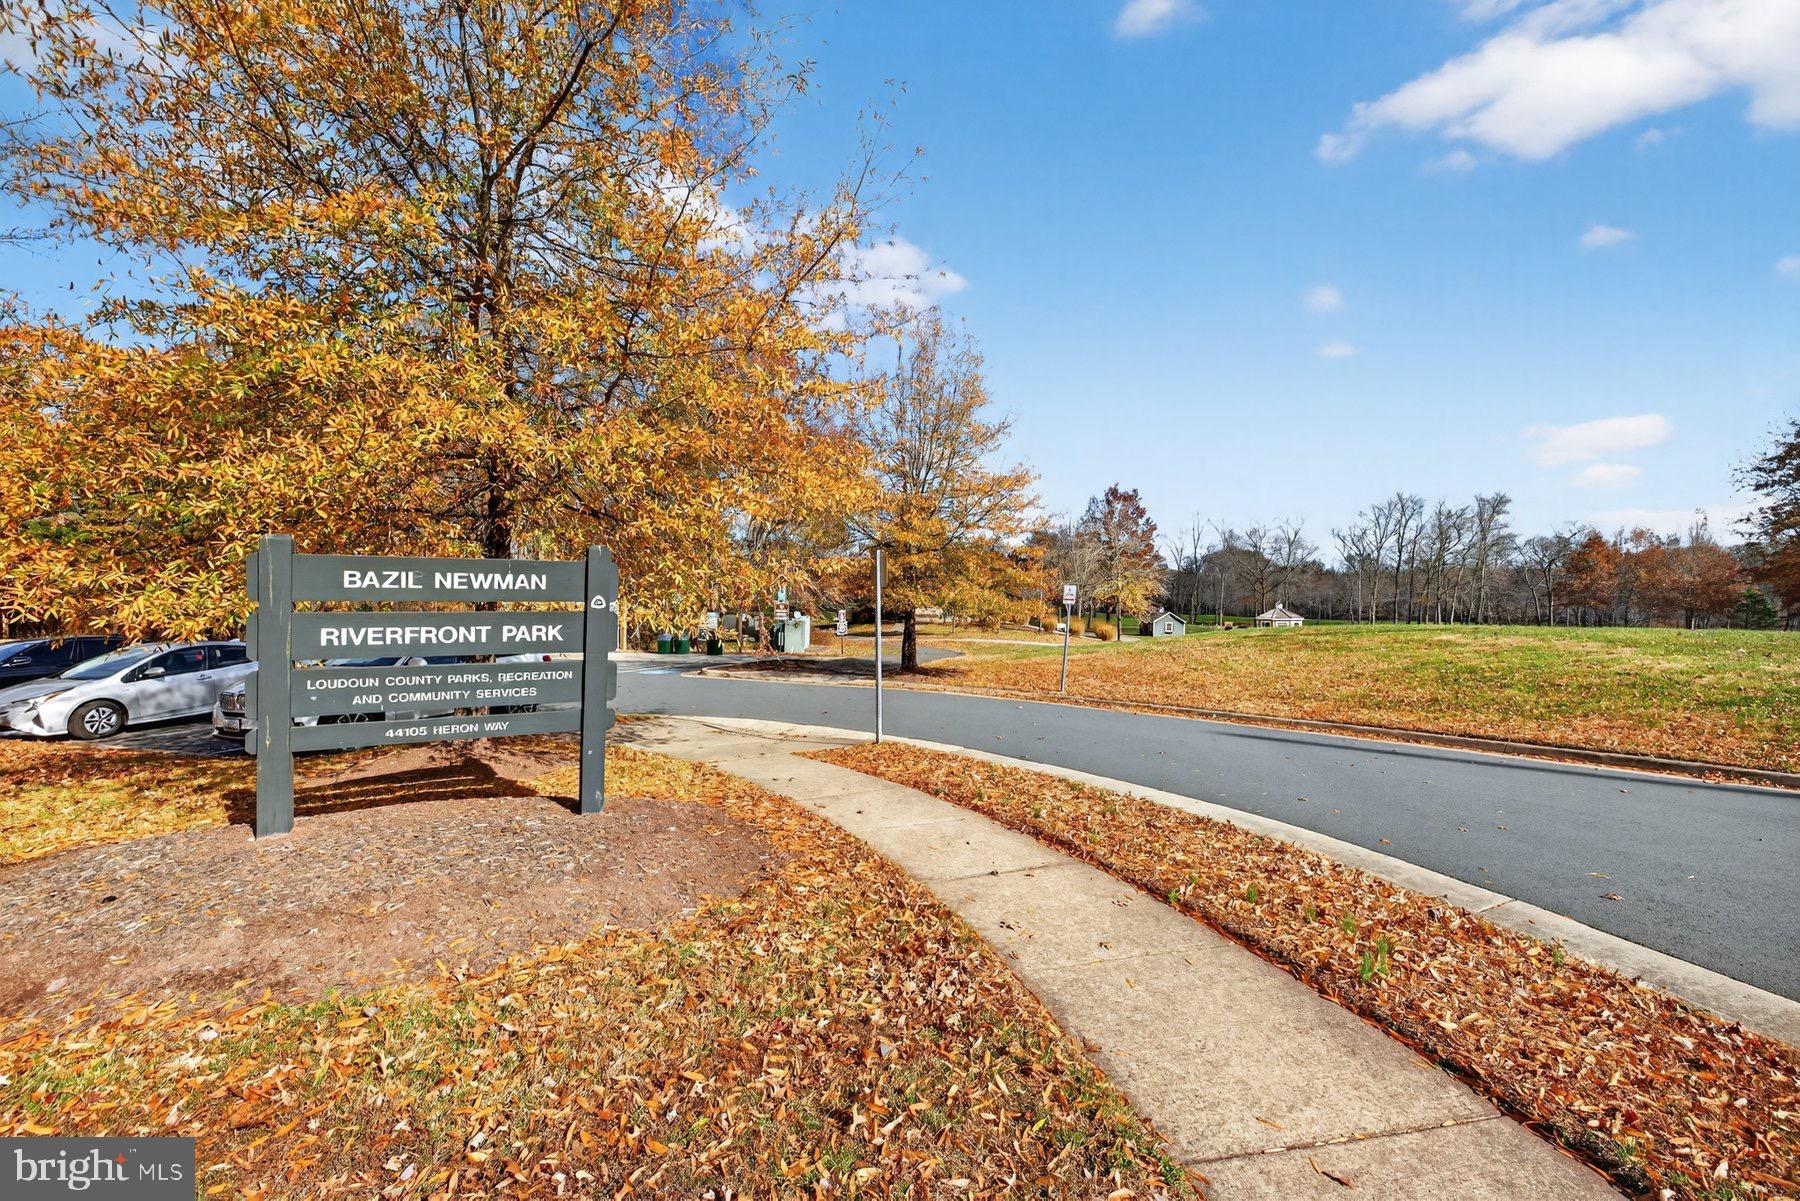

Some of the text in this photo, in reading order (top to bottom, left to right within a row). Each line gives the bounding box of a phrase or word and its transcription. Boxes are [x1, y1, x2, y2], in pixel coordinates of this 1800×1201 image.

[343, 570, 547, 590] BAZIL NEWMAN
[320, 624, 564, 647] RIVERFRONT PARK
[306, 670, 573, 690] LOUDOUN COUNTY PARKS, RECREATION
[352, 687, 538, 705] AND COMMUNITY SERVICES
[385, 721, 510, 739] 44105 HERON WAY
